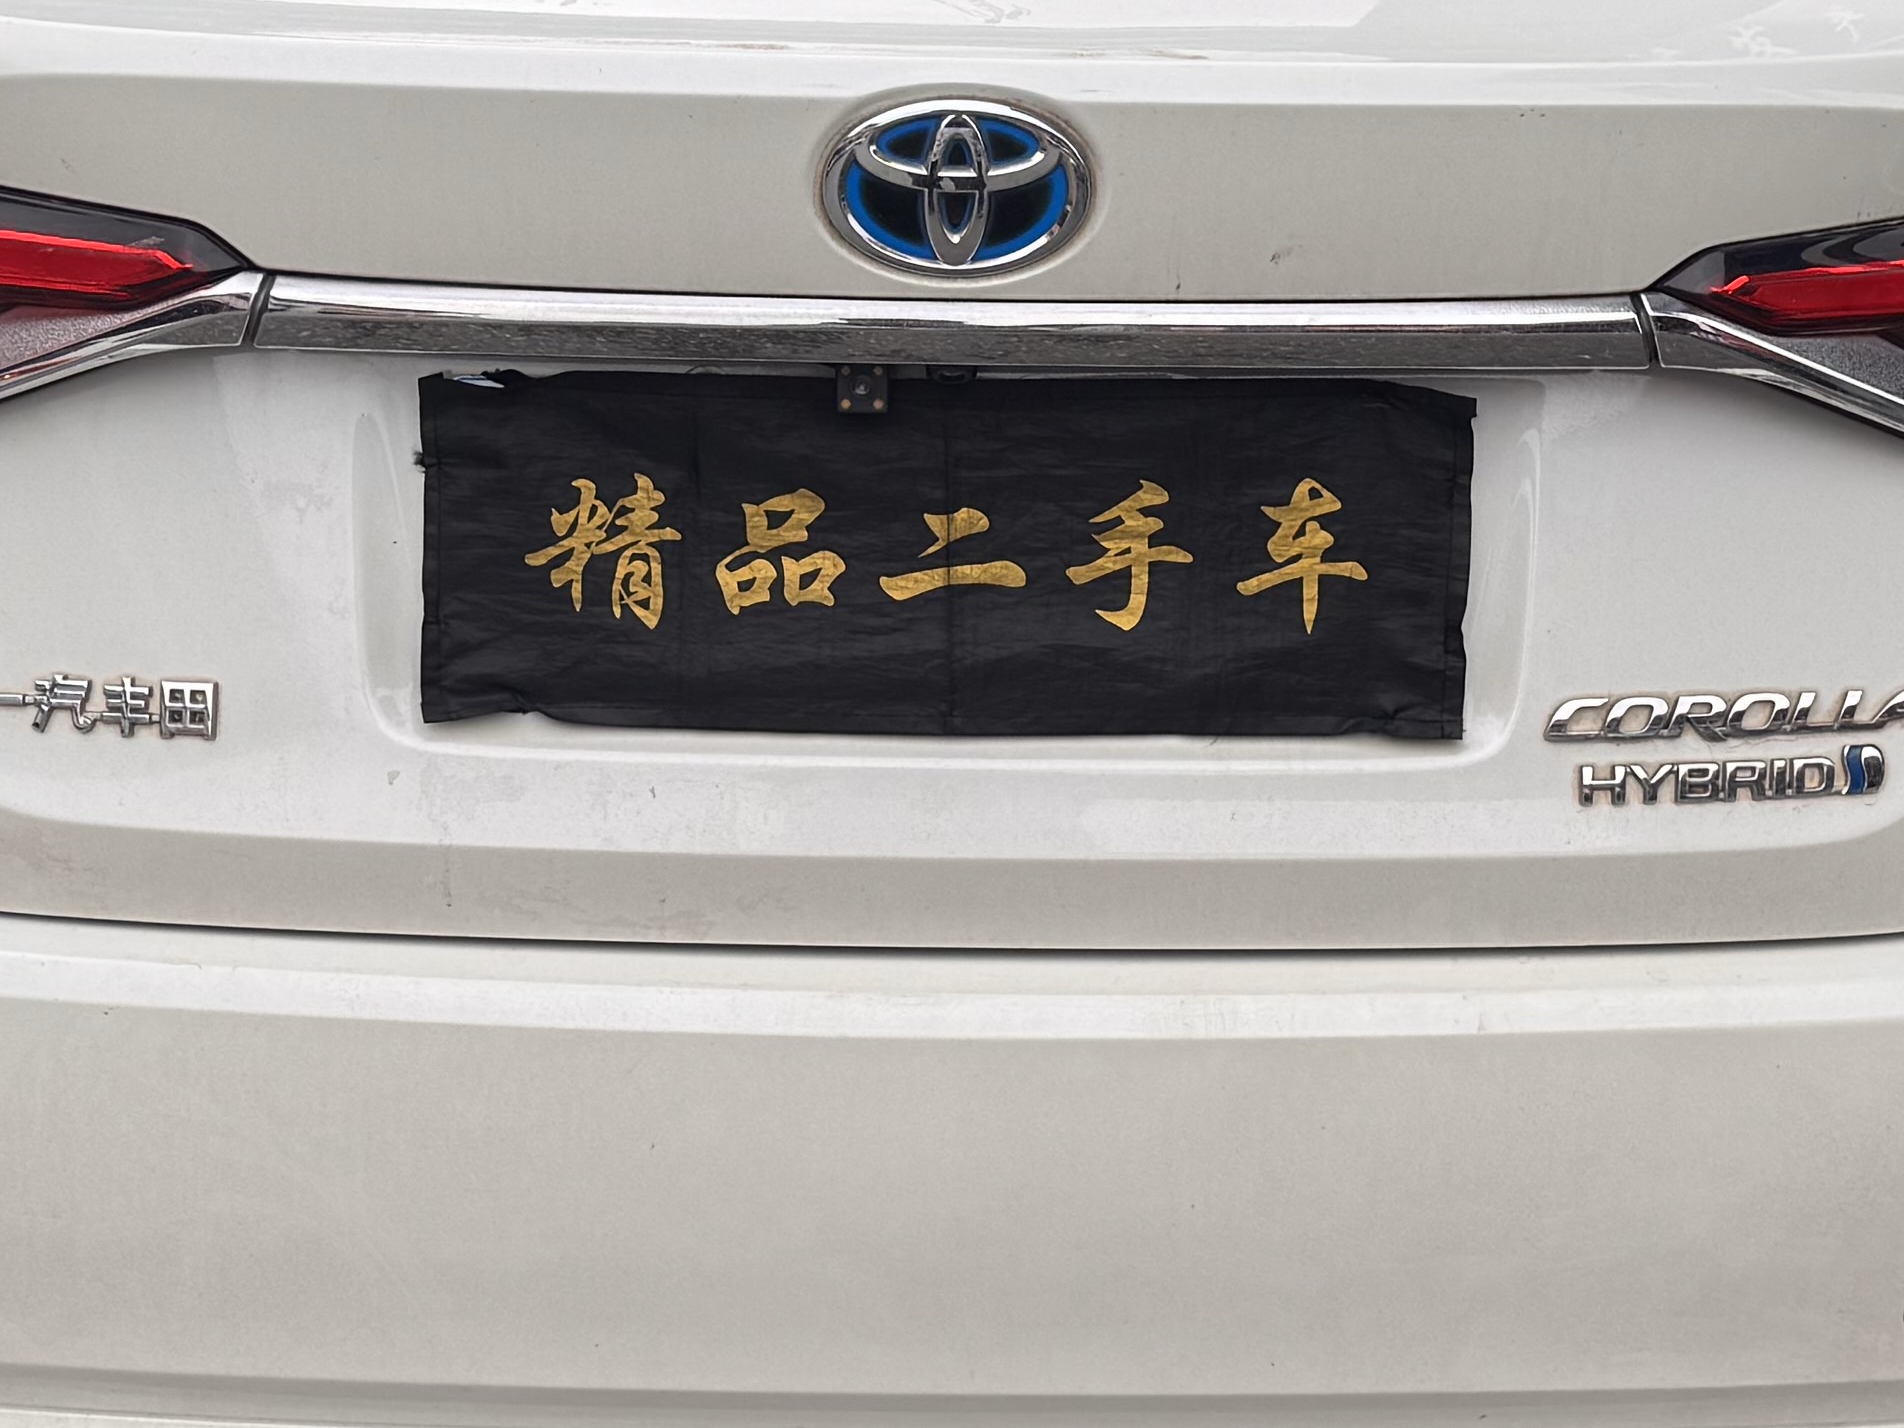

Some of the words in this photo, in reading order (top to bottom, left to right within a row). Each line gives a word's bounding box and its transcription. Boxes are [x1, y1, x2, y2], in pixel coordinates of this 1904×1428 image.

[524, 471, 1369, 635] 精品二手车
[1578, 756, 1836, 807] HYBRID
